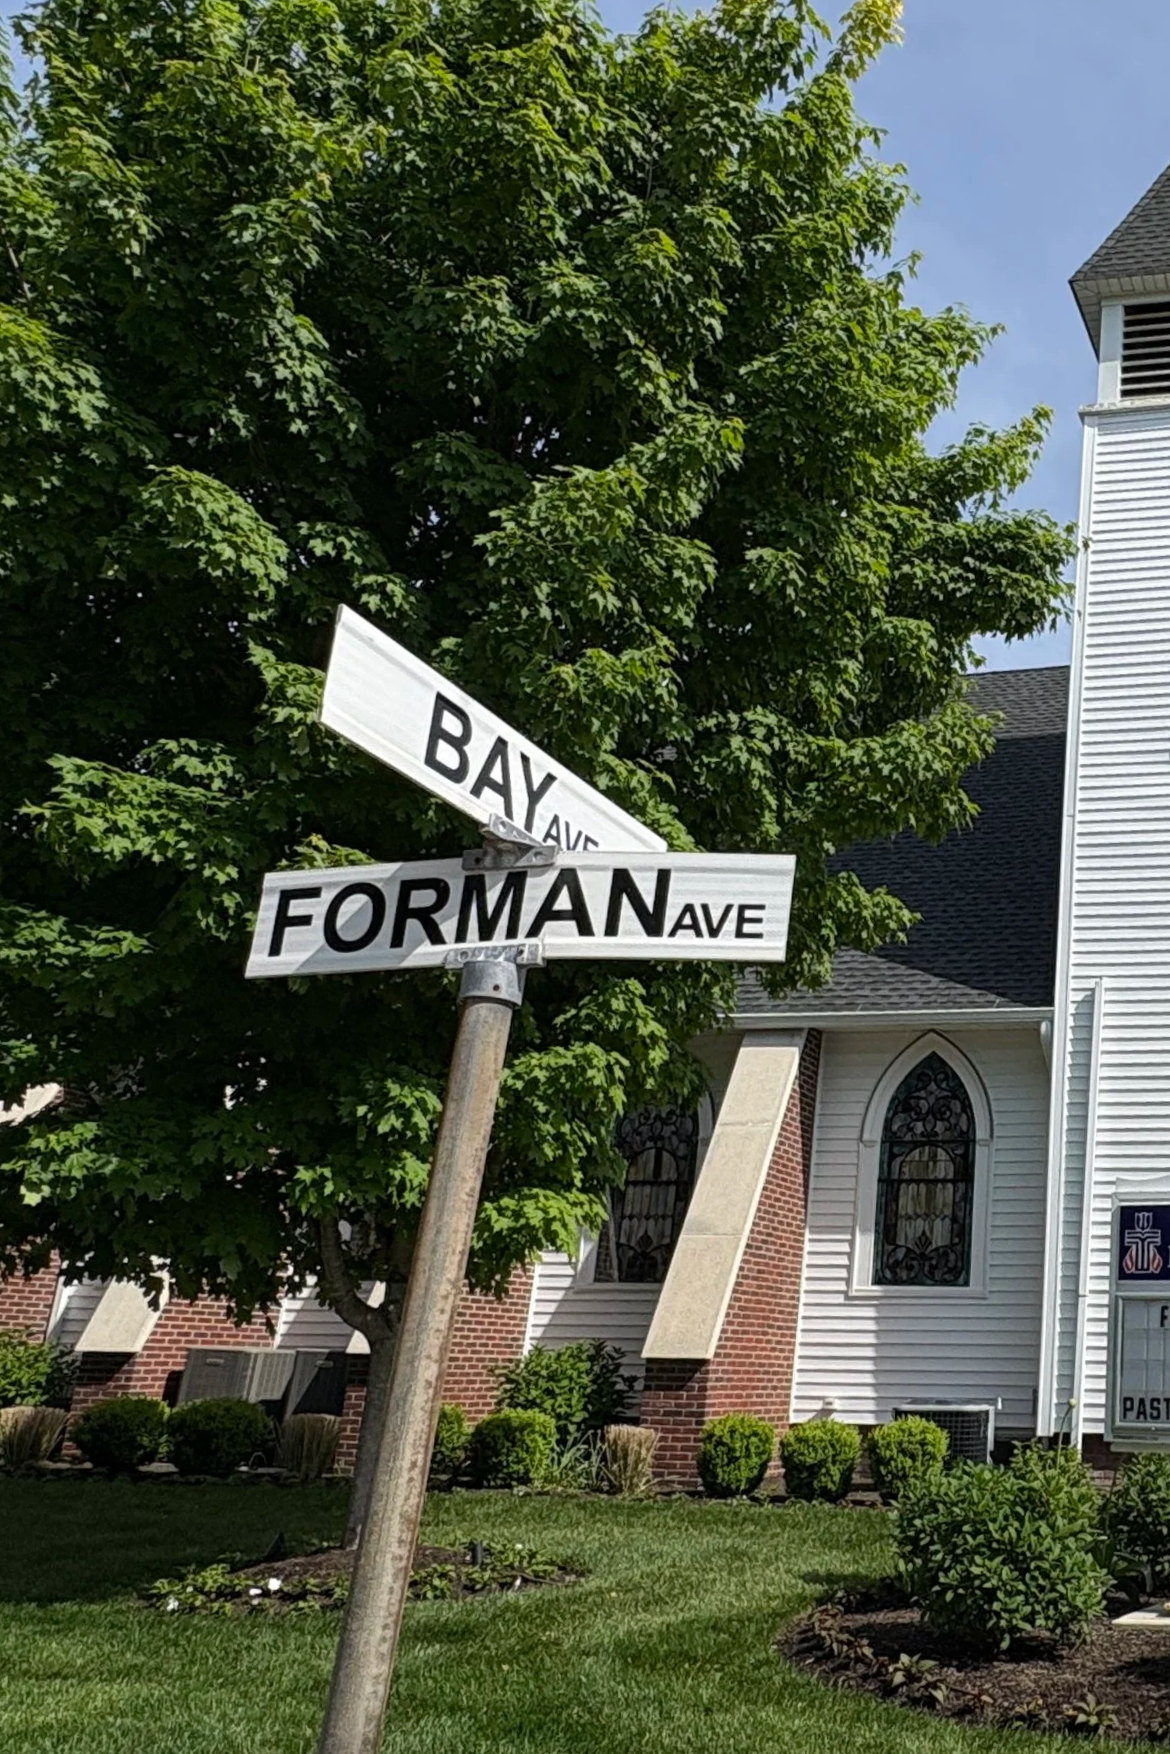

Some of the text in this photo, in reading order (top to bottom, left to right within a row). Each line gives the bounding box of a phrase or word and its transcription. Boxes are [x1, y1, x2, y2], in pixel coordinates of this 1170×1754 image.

[424, 692, 557, 835] BAY
[268, 869, 766, 957] FORMAN AVE
